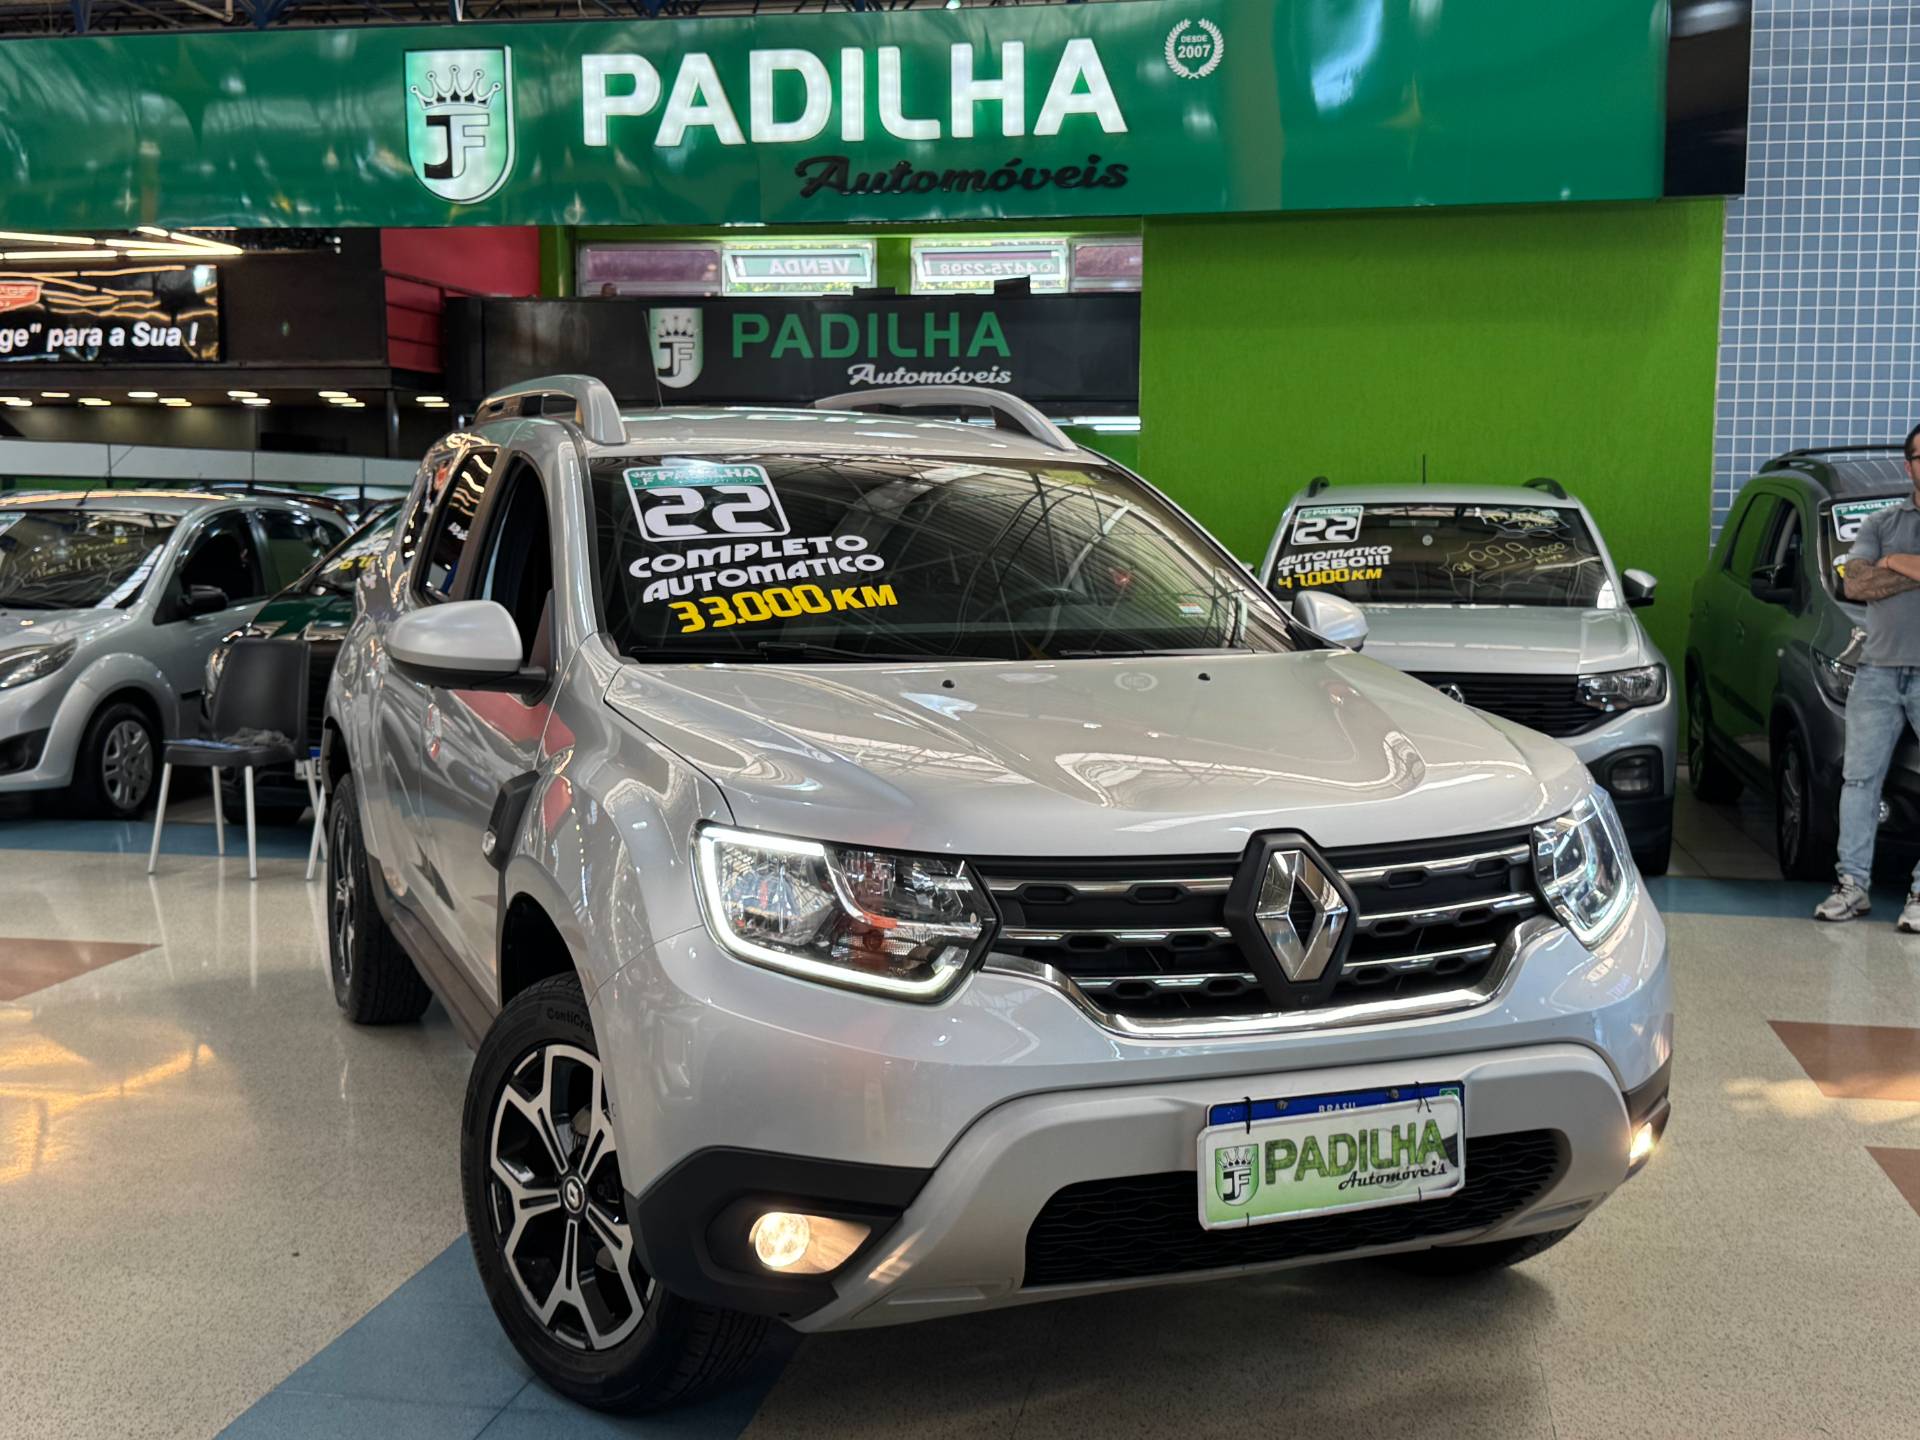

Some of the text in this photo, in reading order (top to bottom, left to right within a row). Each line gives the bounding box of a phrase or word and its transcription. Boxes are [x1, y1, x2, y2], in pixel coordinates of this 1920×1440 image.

[1178, 44, 1211, 58] 2007
[1181, 35, 1208, 43] DESDE
[582, 38, 1129, 147] PADILHA
[795, 155, 1129, 198] Automóveis
[46, 327, 103, 352] para
[108, 328, 125, 347] a
[131, 321, 183, 347] Sua
[732, 311, 1012, 359] PADILHA
[847, 362, 1012, 386] Automóveis
[644, 485, 775, 536] 22
[1295, 516, 1357, 542] 22
[629, 535, 868, 578] COMPLETO
[1264, 1119, 1448, 1185] PADILHA
[1338, 1160, 1448, 1190] Automóveis
